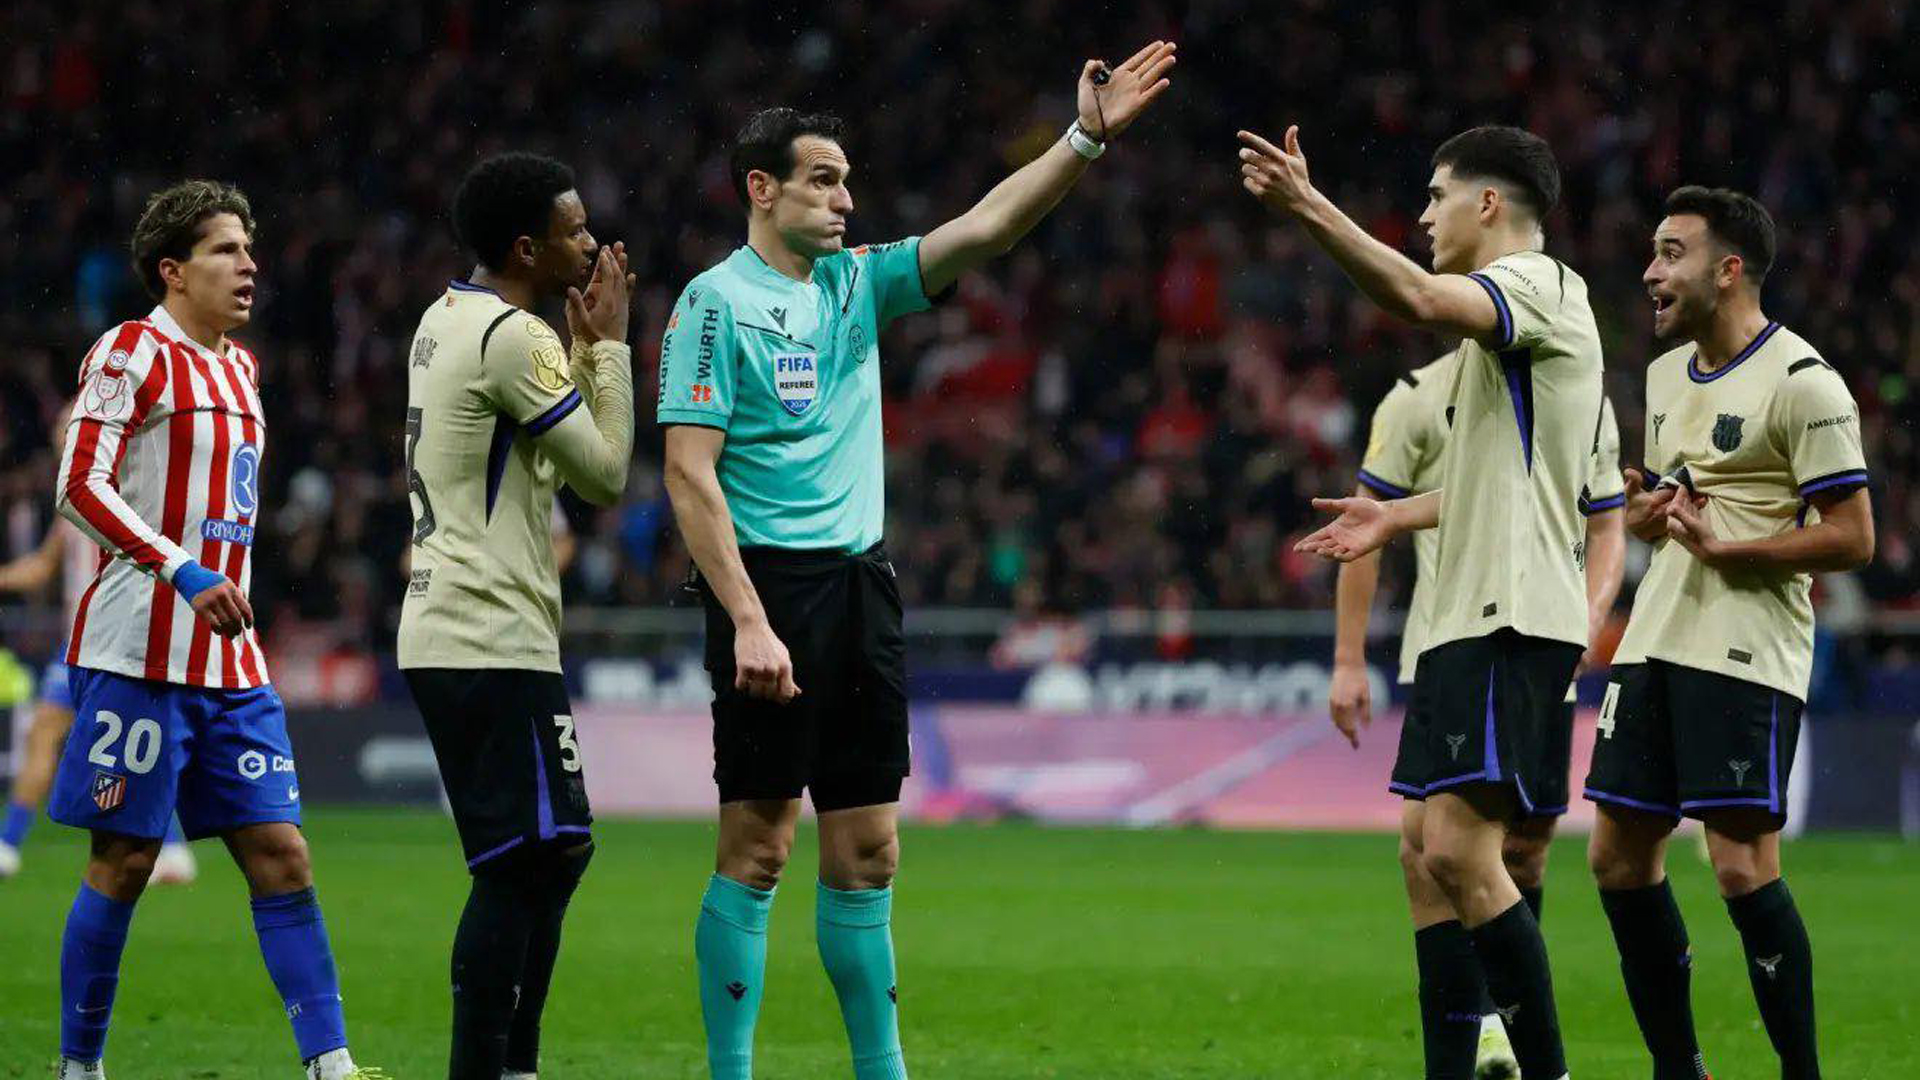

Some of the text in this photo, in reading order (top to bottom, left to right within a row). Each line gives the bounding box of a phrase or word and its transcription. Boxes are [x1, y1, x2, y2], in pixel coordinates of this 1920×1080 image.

[697, 308, 719, 379] WÜRTH
[777, 357, 813, 372] FIFA
[779, 380, 815, 389] REFEREE
[204, 520, 253, 545] RIYADH
[1596, 681, 1621, 739] 4
[88, 710, 162, 774] 20
[553, 714, 581, 773] 3
